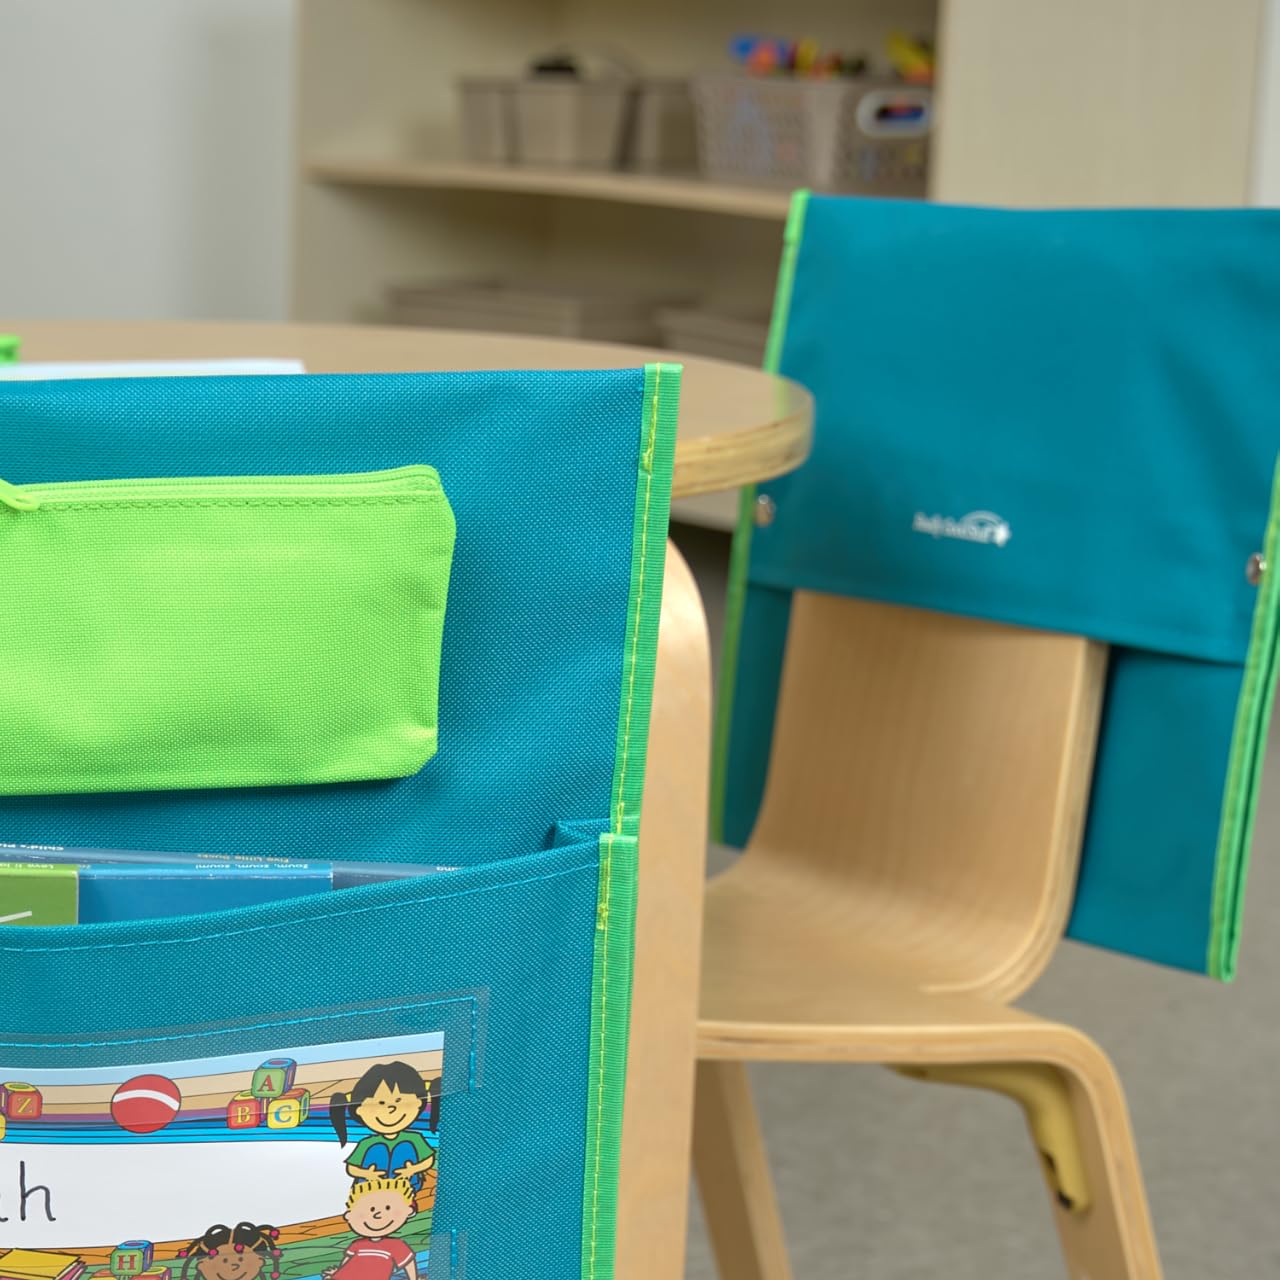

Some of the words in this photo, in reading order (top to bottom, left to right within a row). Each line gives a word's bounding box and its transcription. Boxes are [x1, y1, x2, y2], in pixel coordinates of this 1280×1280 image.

[256, 1073, 276, 1093] A
[16, 1096, 33, 1114] Z
[235, 1105, 251, 1124] B
[273, 1104, 293, 1123] C
[116, 1254, 137, 1271] H
